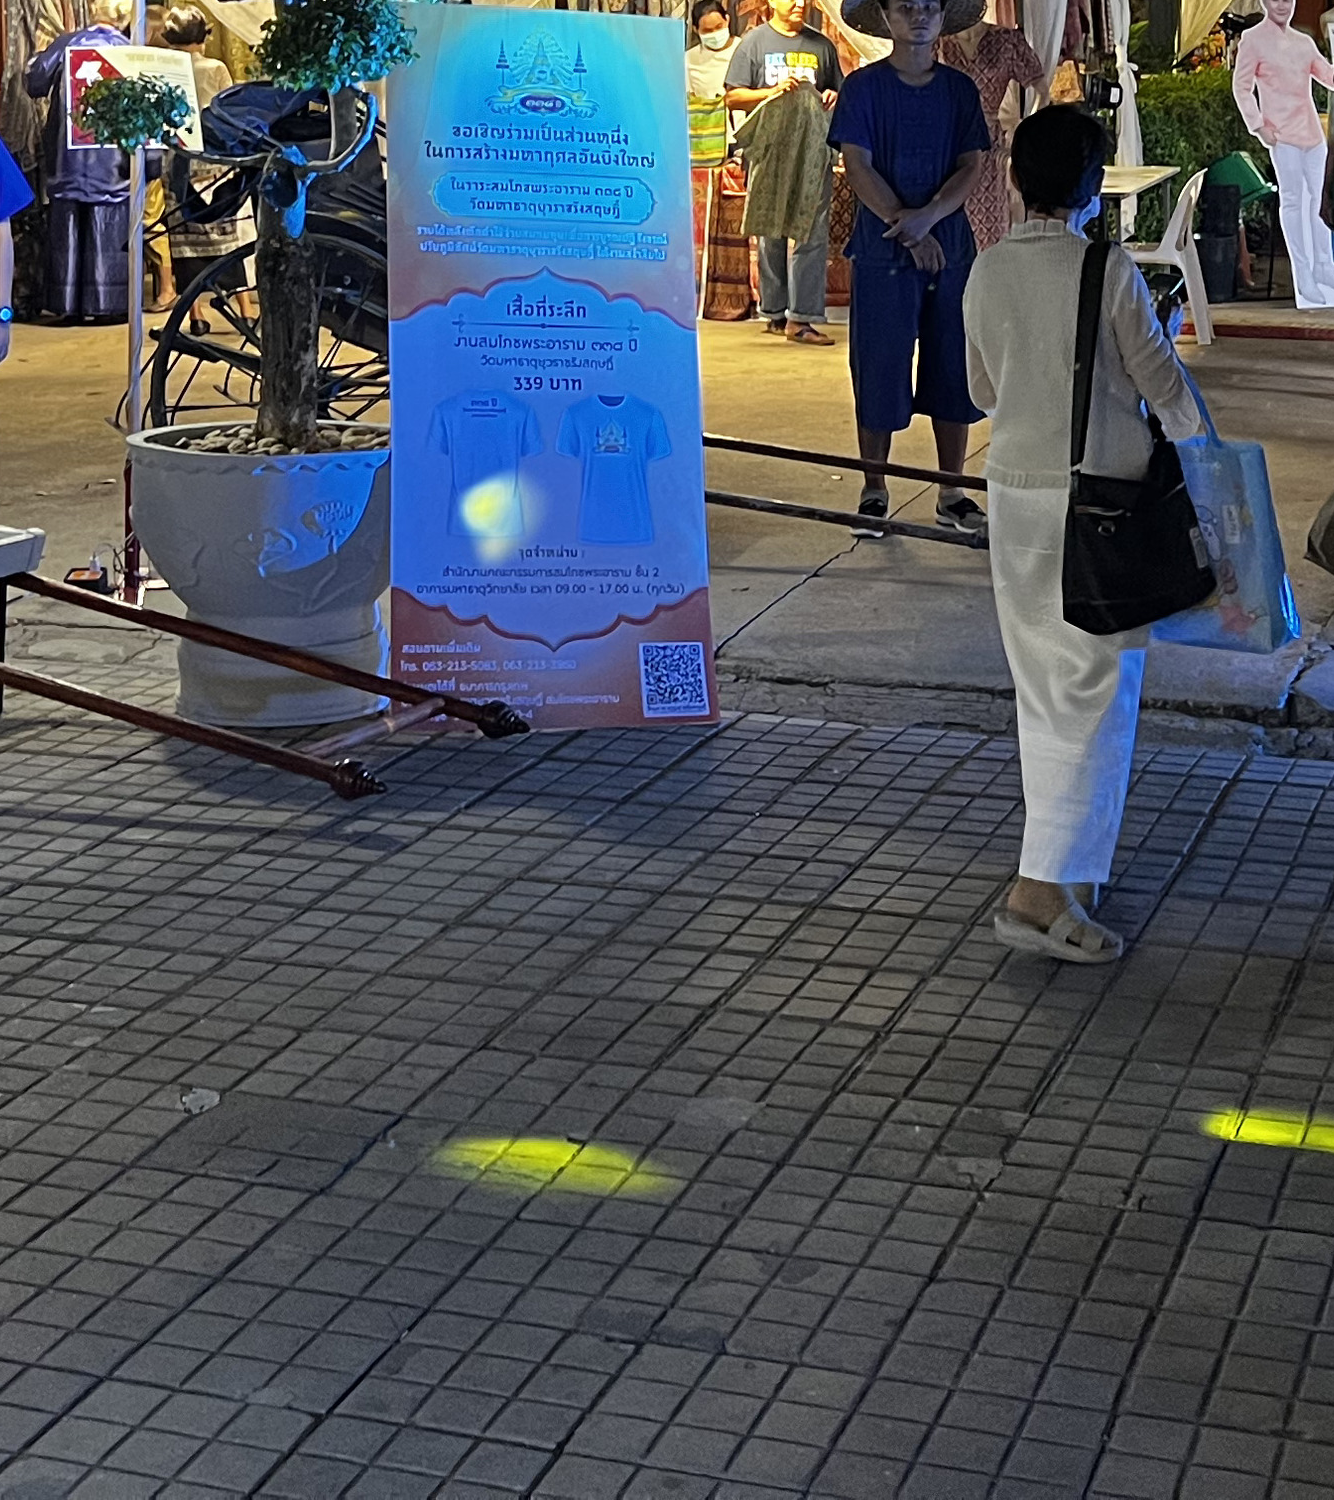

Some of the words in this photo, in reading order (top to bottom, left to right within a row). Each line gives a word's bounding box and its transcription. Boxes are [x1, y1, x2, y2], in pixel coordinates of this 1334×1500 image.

[452, 122, 629, 147] ขอเชิญร่วมเป็นส่วนหนึ่ง
[424, 141, 656, 168] ในการสร้างมหากุศลอันยิ่งใหญ่
[507, 293, 587, 318] เสื้อที่ระลึก
[454, 334, 586, 351] งานสมโภชพระอาราม
[629, 337, 638, 352] ปี
[513, 376, 543, 391] 339
[549, 377, 582, 391] บาท
[653, 568, 659, 577] 2
[555, 583, 586, 594] 09.00
[599, 583, 629, 595] 17.00
